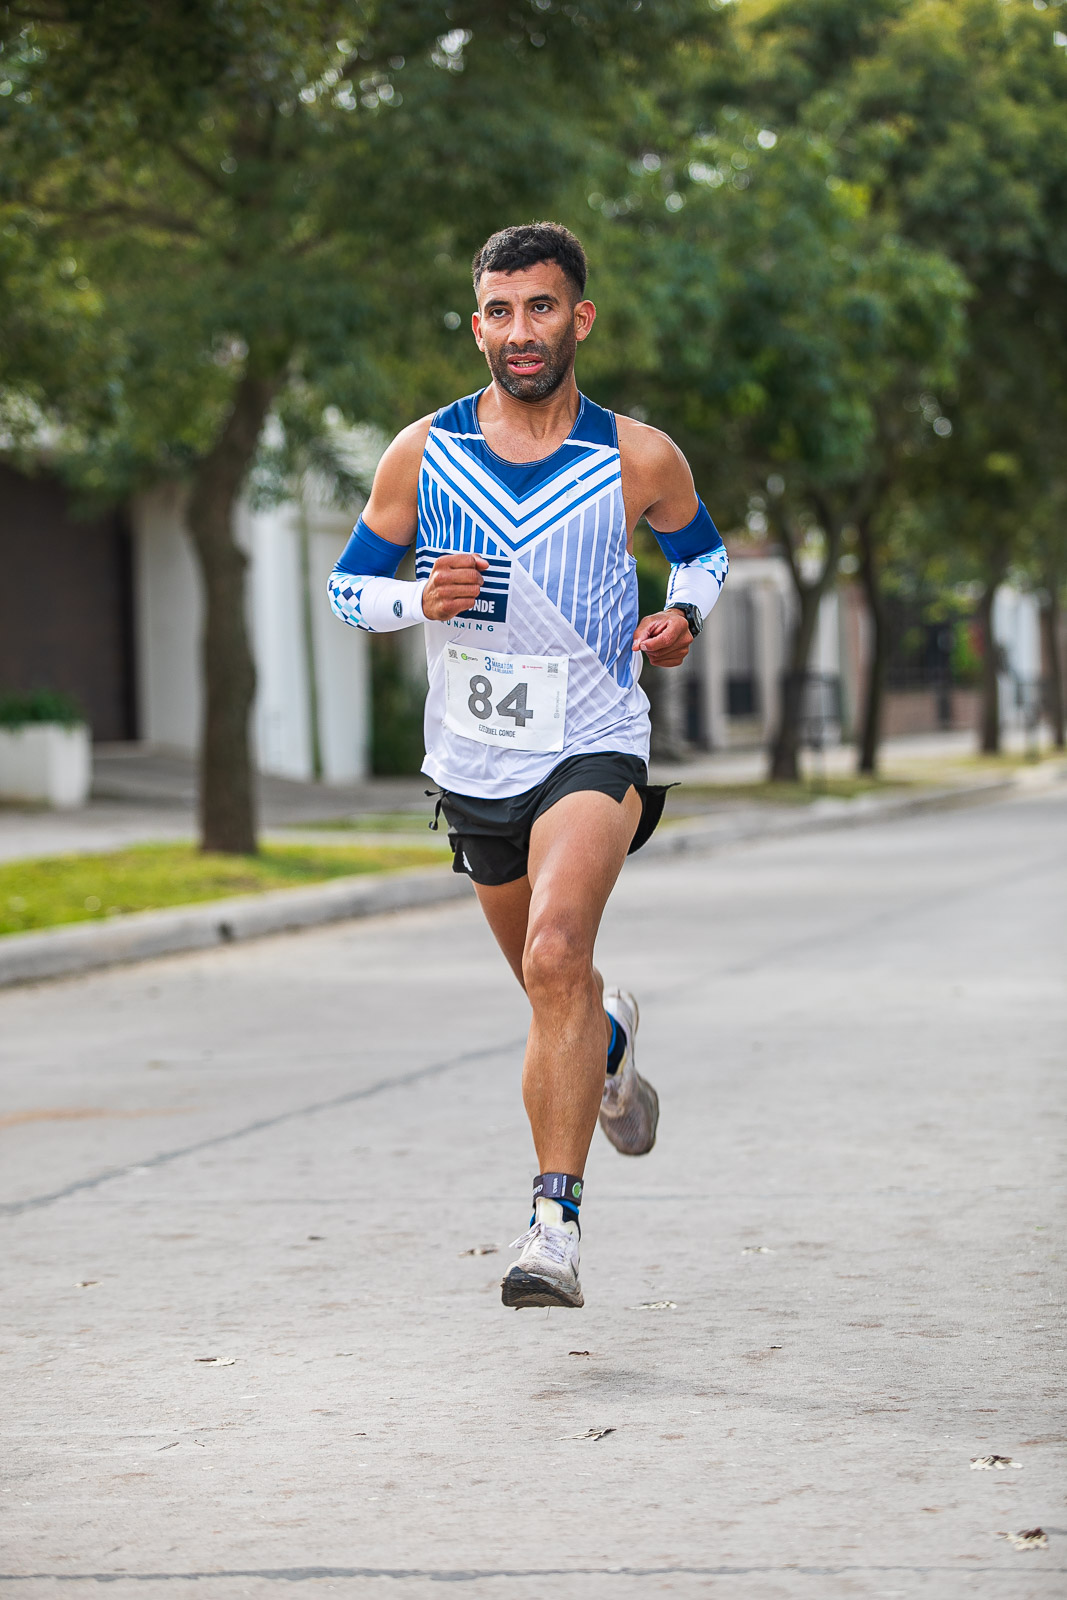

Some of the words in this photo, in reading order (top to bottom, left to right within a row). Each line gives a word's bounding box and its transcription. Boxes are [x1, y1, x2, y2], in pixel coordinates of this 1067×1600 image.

[468, 598, 496, 614] NDE
[468, 674, 534, 727] 84
[498, 729, 516, 738] CONDE
